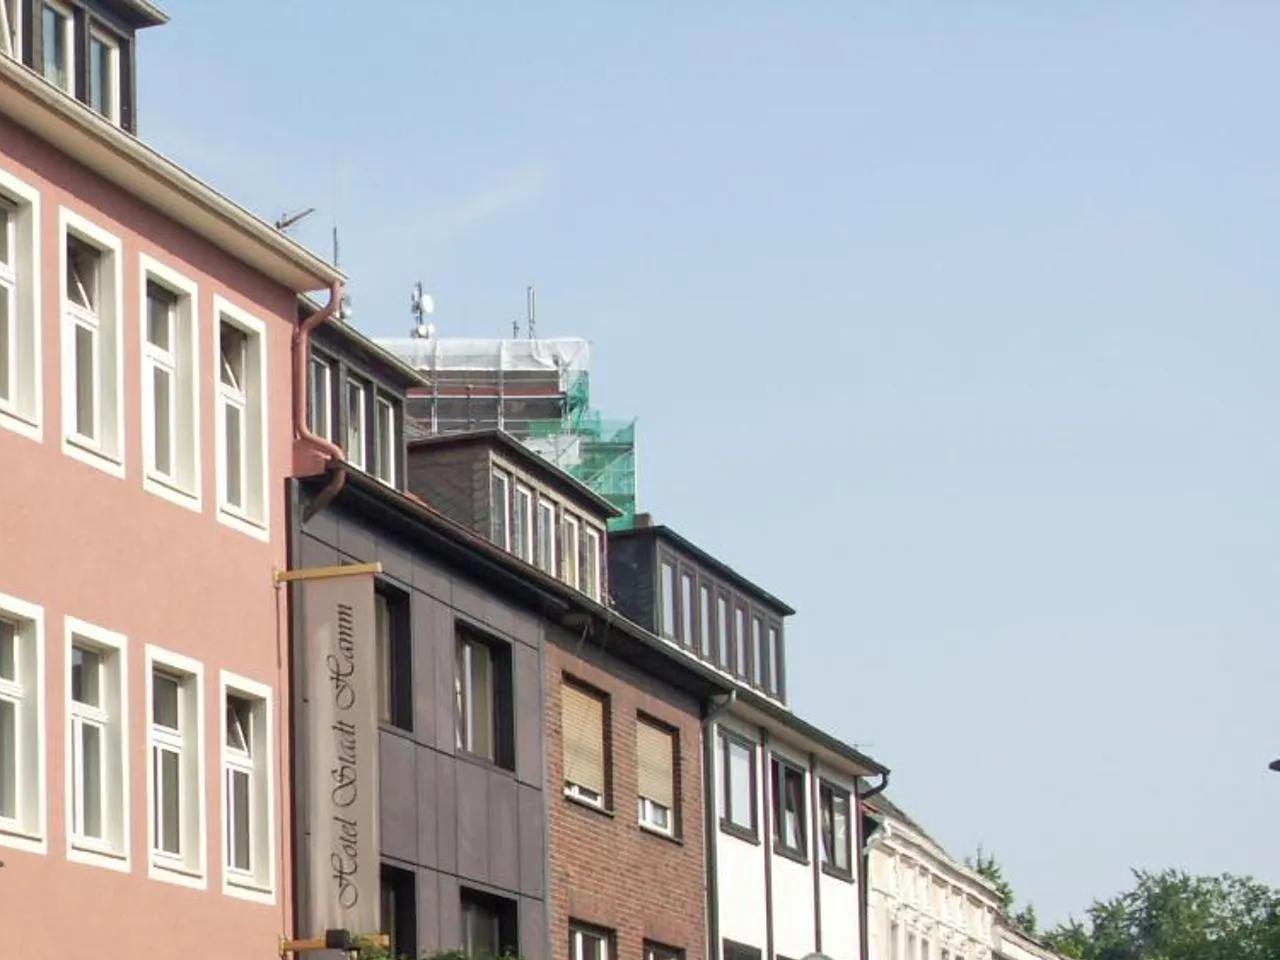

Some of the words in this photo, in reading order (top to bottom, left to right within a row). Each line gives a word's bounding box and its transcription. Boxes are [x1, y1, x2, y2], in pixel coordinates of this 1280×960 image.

[326, 603, 355, 710] Hamm
[331, 719, 357, 808] Stadt
[330, 816, 358, 909] Hotel
